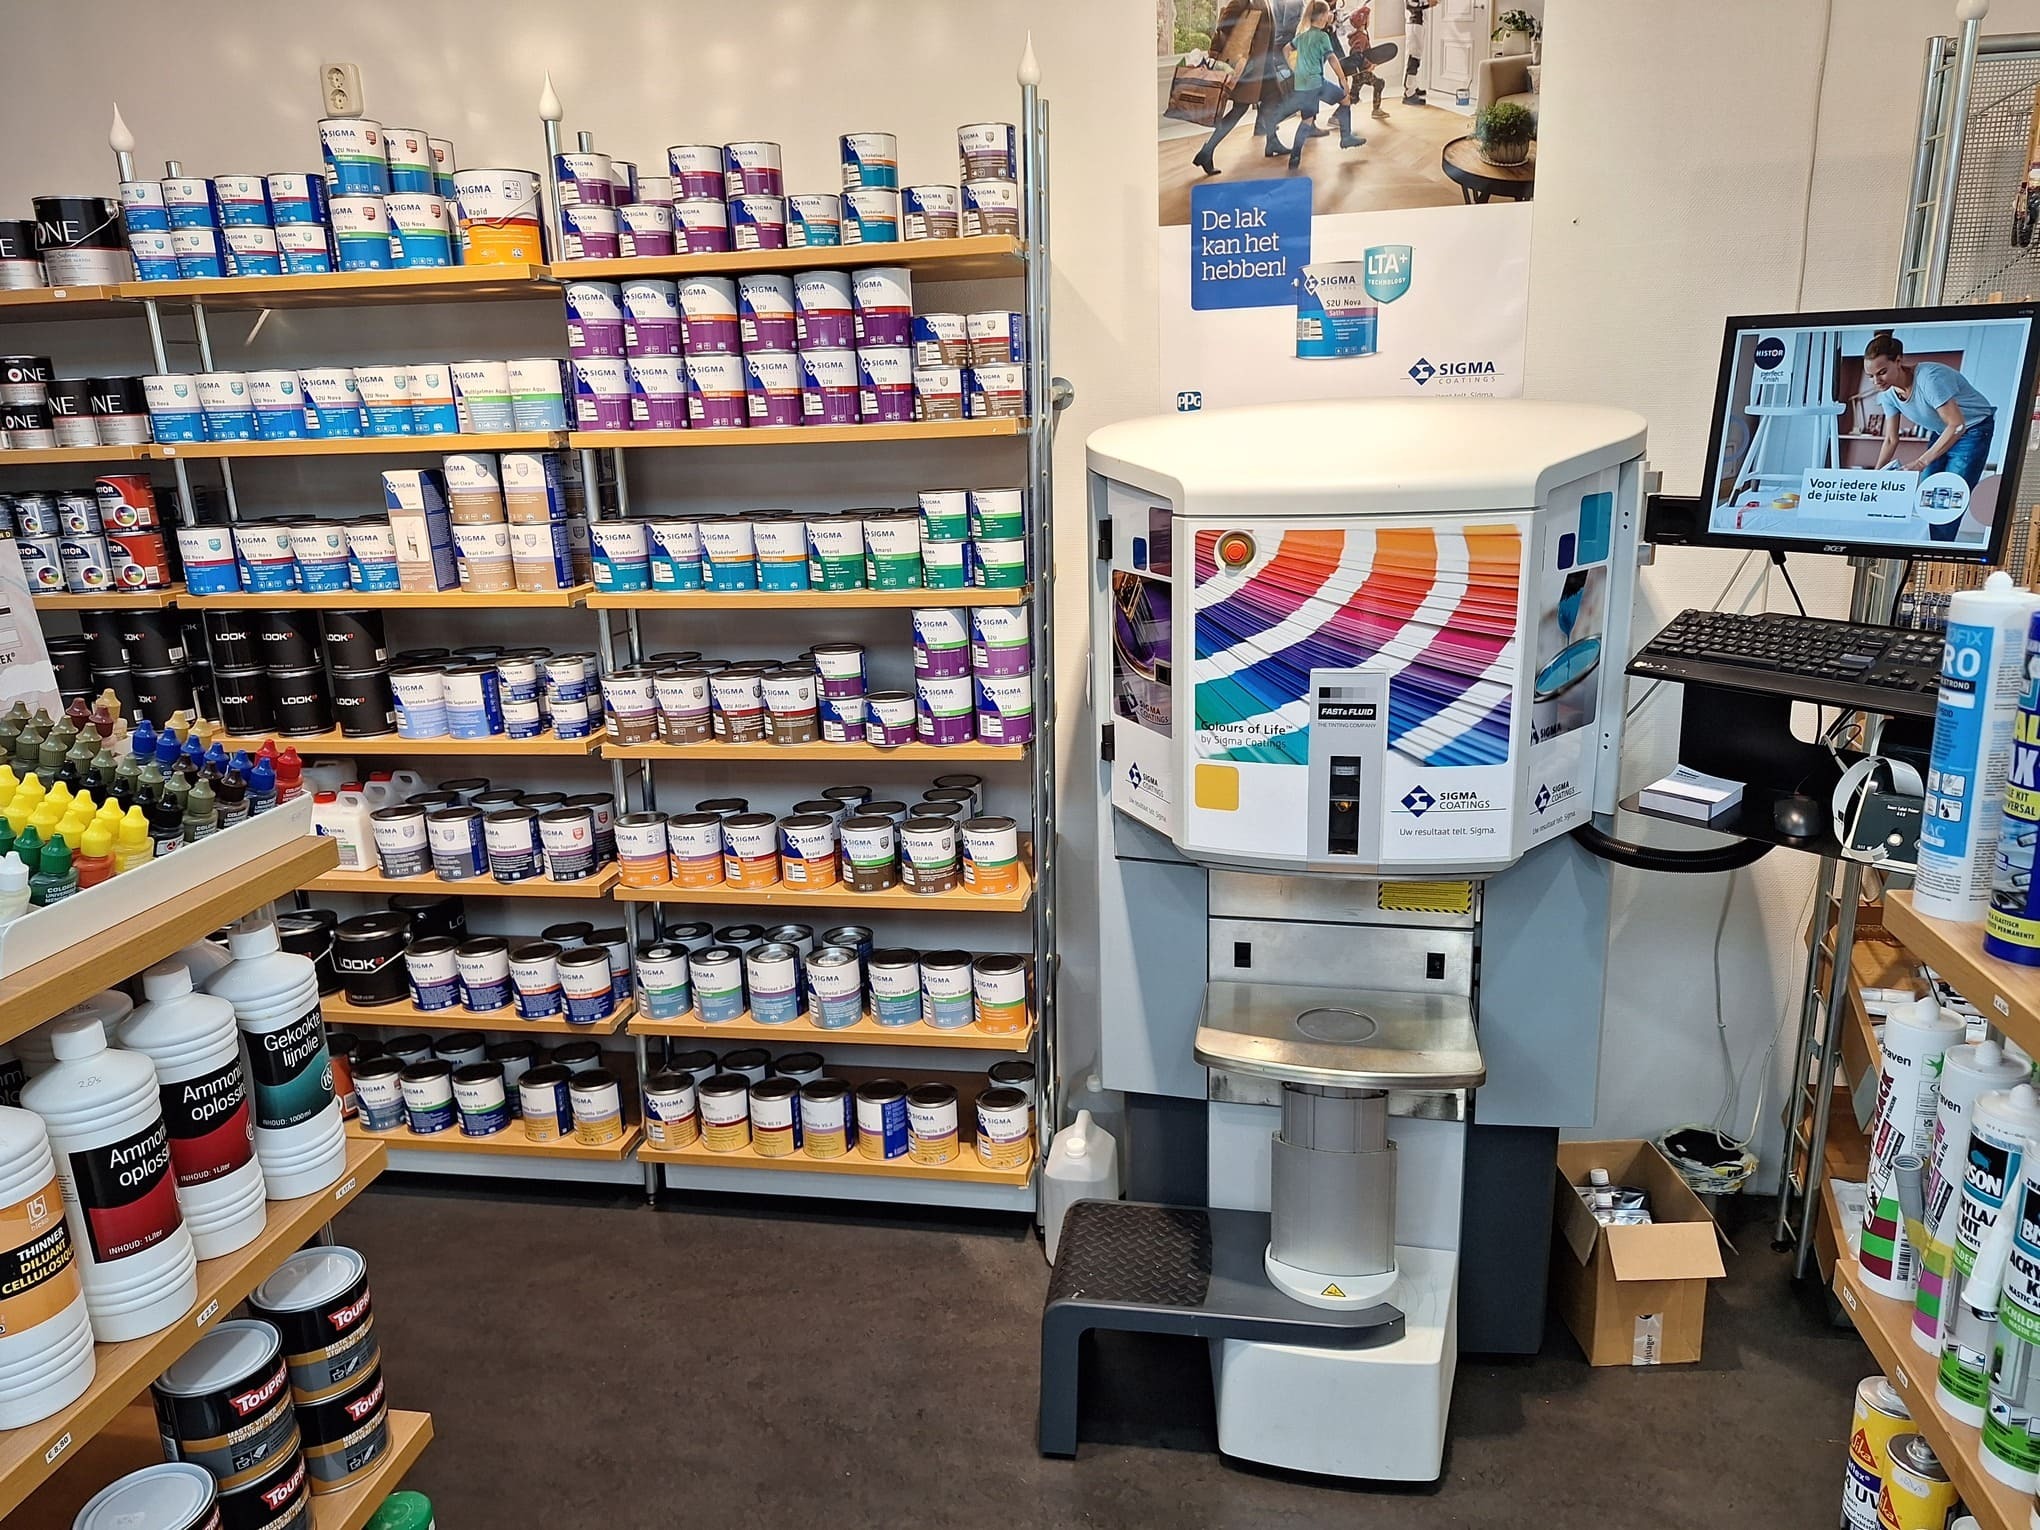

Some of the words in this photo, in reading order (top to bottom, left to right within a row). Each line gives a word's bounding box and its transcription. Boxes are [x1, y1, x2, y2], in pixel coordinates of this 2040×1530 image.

[461, 185, 491, 195] SIGMA
[469, 208, 488, 216] Rapid
[1202, 210, 1231, 231] De
[1235, 208, 1266, 229] lak
[37, 220, 79, 245] ONE
[1202, 237, 1241, 256] kan
[1244, 232, 1279, 253] het
[1202, 256, 1287, 281] hebben!
[800, 283, 826, 291] SIGMA
[857, 281, 882, 289] SIGMA
[1320, 275, 1356, 286] SIGMA
[1368, 277, 1406, 286] TECHNOLOGY
[751, 286, 778, 294] SIGMA
[1326, 299, 1341, 307] S2U
[1756, 349, 1784, 357] HISTOR
[871, 359, 898, 367] SIGMA
[1439, 361, 1496, 376] SIGMA
[8, 367, 45, 382] ONE
[458, 371, 485, 379] SIGMA
[1438, 376, 1496, 385] COATINGS
[1760, 370, 1784, 379] perfect
[1177, 393, 1201, 412] PPG
[5, 413, 40, 429] ONE
[1810, 478, 1836, 489] Voor
[1840, 479, 1878, 491] iedere
[1881, 480, 1906, 492] klus
[1808, 490, 1822, 500] de
[1824, 490, 1857, 503] juiste
[1860, 491, 1878, 502] lak
[1823, 544, 1847, 553] acer
[215, 631, 247, 642] LOOK
[262, 632, 288, 642] LOOK
[996, 687, 1021, 695] SIGMA
[221, 695, 248, 704] LOOK
[281, 695, 312, 705] LOOK
[1139, 701, 1161, 715] SIGMA
[1140, 709, 1169, 723] COATINGS
[1201, 721, 1244, 733] Colours
[1247, 724, 1260, 734] of
[1540, 723, 1562, 738] SIGMA
[1201, 735, 1212, 745] by
[1215, 736, 1243, 747] Sigma
[1246, 737, 1286, 749] Coatings
[1143, 773, 1158, 786] SIGMA
[1142, 782, 1164, 798] COATINGS
[1552, 781, 1570, 793] SIGMA
[1440, 792, 1477, 800] SIGMA
[1552, 787, 1575, 802] COATINGS
[1440, 801, 1490, 810] COATINGS
[1400, 828, 1413, 836] Uw
[1415, 828, 1450, 836] resultaat
[1470, 827, 1496, 837] Sigma.
[264, 1011, 321, 1052] Gekookte
[283, 1034, 319, 1068] lijnolie
[660, 1098, 684, 1108] SIGMA
[263, 1116, 289, 1127] INHOUD:
[181, 1169, 212, 1182] INHOUD:
[1961, 1216, 1981, 1237] KIT
[17, 1227, 65, 1262] THINNER
[109, 1239, 144, 1255] INHOUD:
[20, 1238, 67, 1274] DILUANT
[1852, 1434, 1872, 1463] Sika
